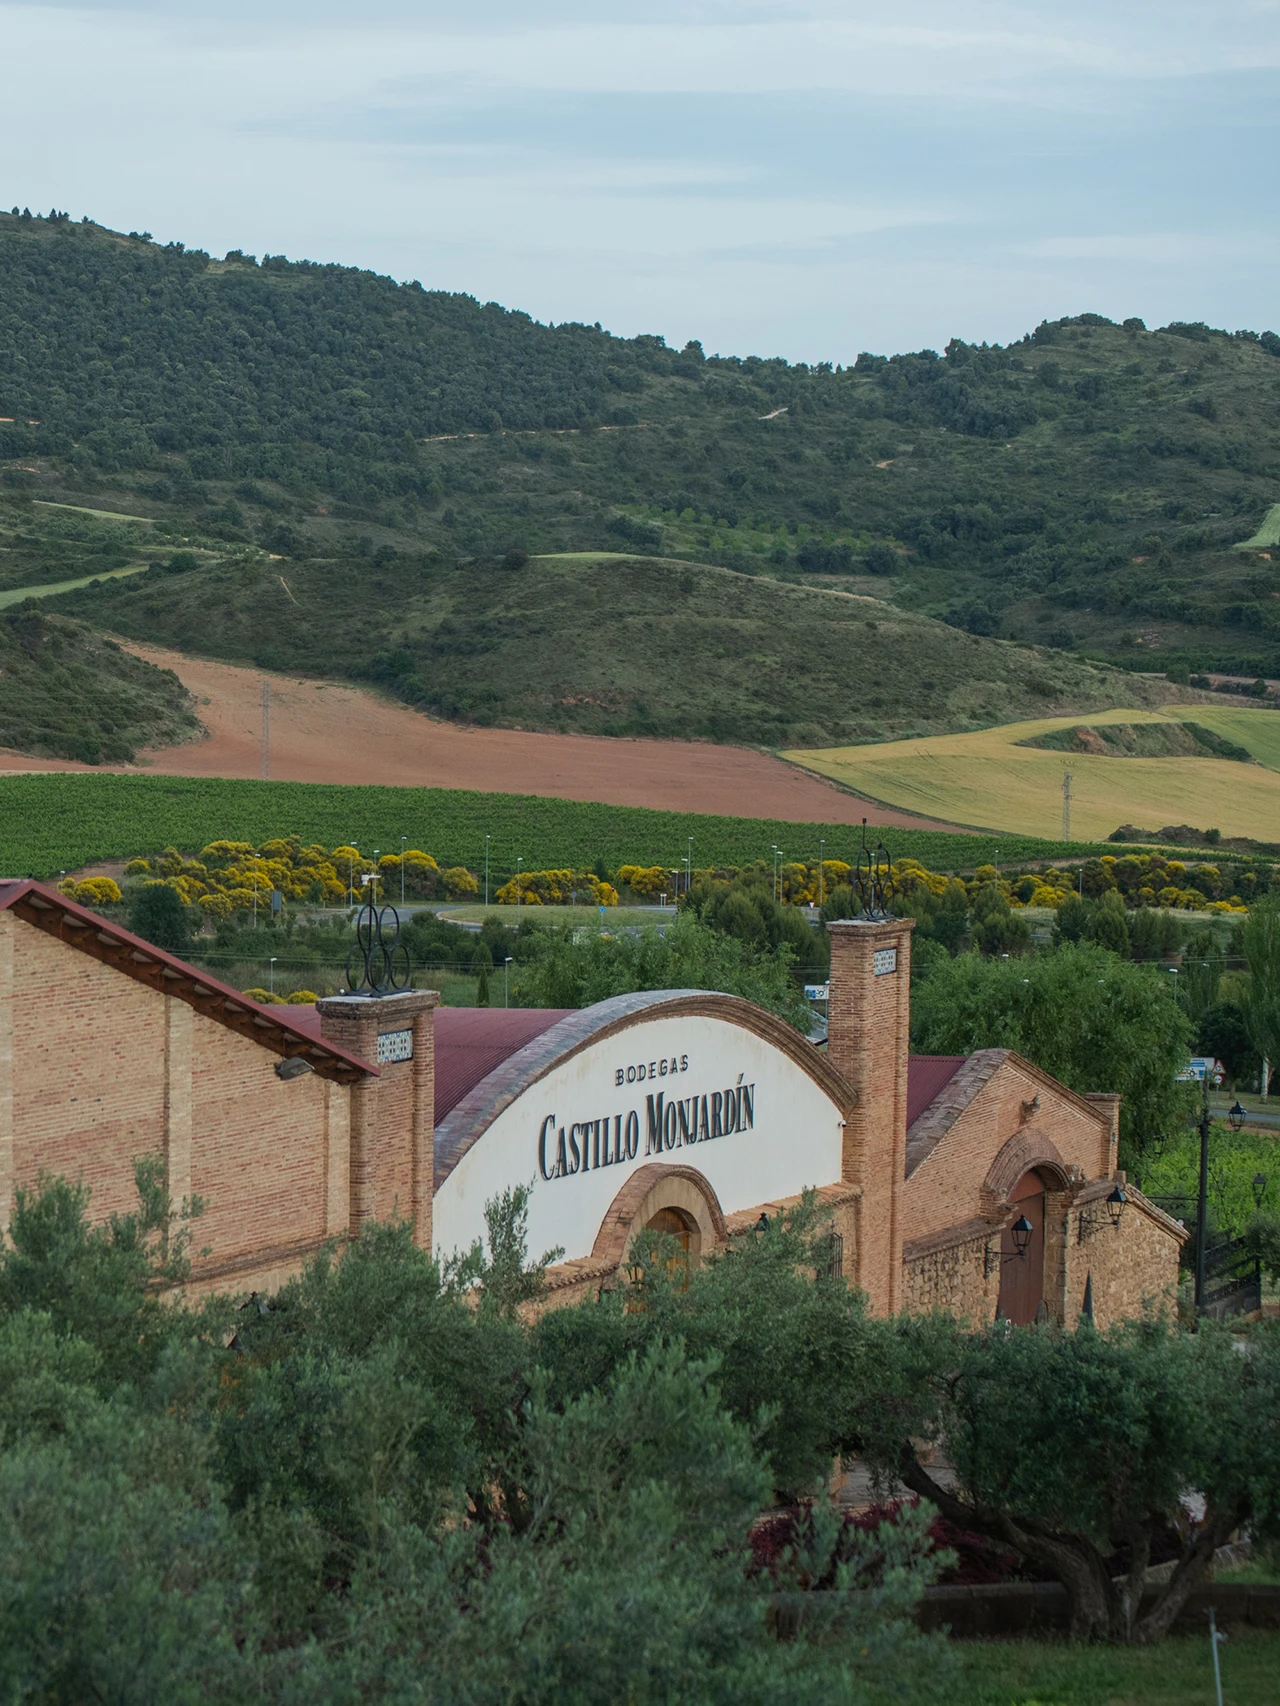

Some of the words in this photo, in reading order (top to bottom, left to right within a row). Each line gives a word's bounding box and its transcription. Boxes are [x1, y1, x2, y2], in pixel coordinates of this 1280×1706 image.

[615, 1054, 689, 1087] BODEGAS
[538, 1110, 639, 1181] CASTILLO
[644, 1073, 756, 1157] MONJARDÍN
